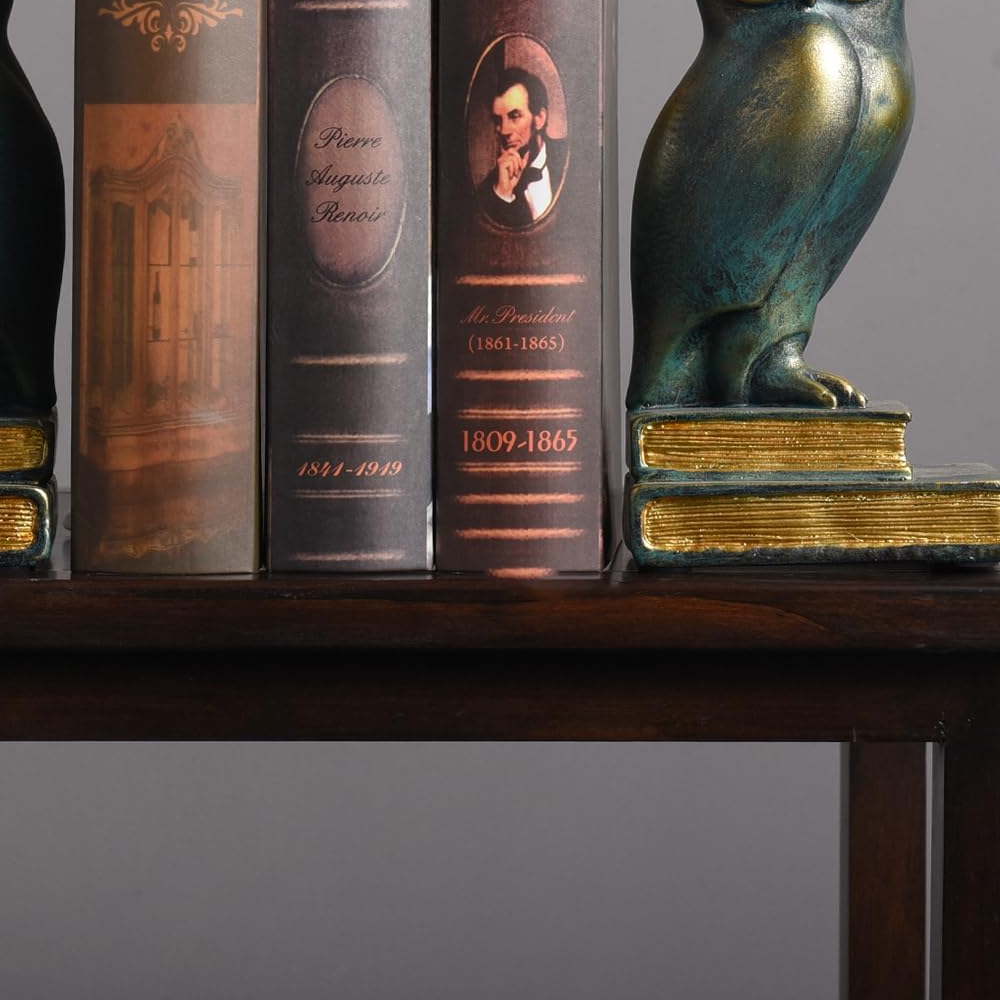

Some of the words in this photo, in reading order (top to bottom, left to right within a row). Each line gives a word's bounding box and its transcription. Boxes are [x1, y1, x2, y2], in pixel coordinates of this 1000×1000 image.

[314, 126, 383, 149] Pierre
[305, 163, 391, 193] Auguste
[311, 200, 386, 224] Renoir
[460, 305, 489, 325] Mr.
[492, 304, 576, 325] President
[468, 333, 566, 353] (1861-1865)
[462, 429, 578, 453] 1809-1865
[297, 460, 403, 477] 1841-1919
